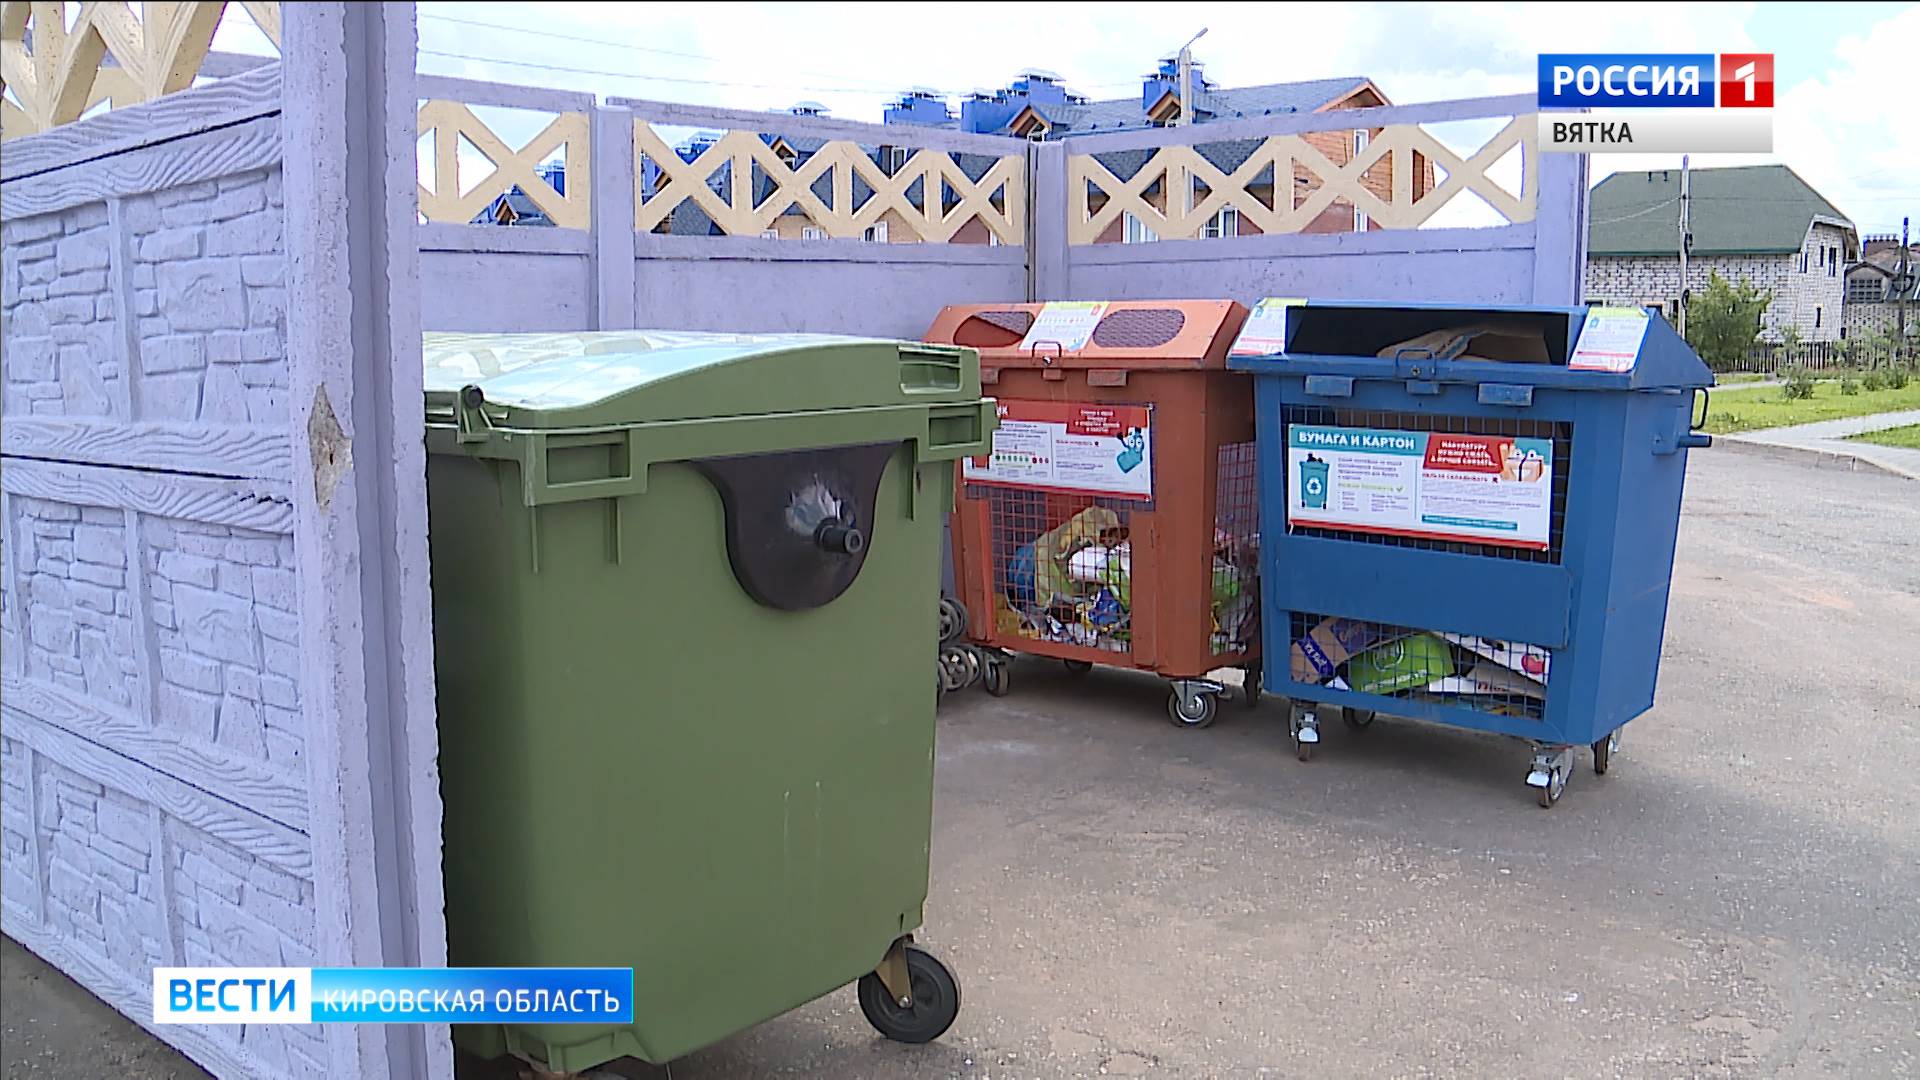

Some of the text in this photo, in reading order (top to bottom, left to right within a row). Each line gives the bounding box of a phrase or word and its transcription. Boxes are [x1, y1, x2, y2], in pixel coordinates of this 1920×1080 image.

[1299, 431, 1415, 450] БУМАГА И КАРТОН
